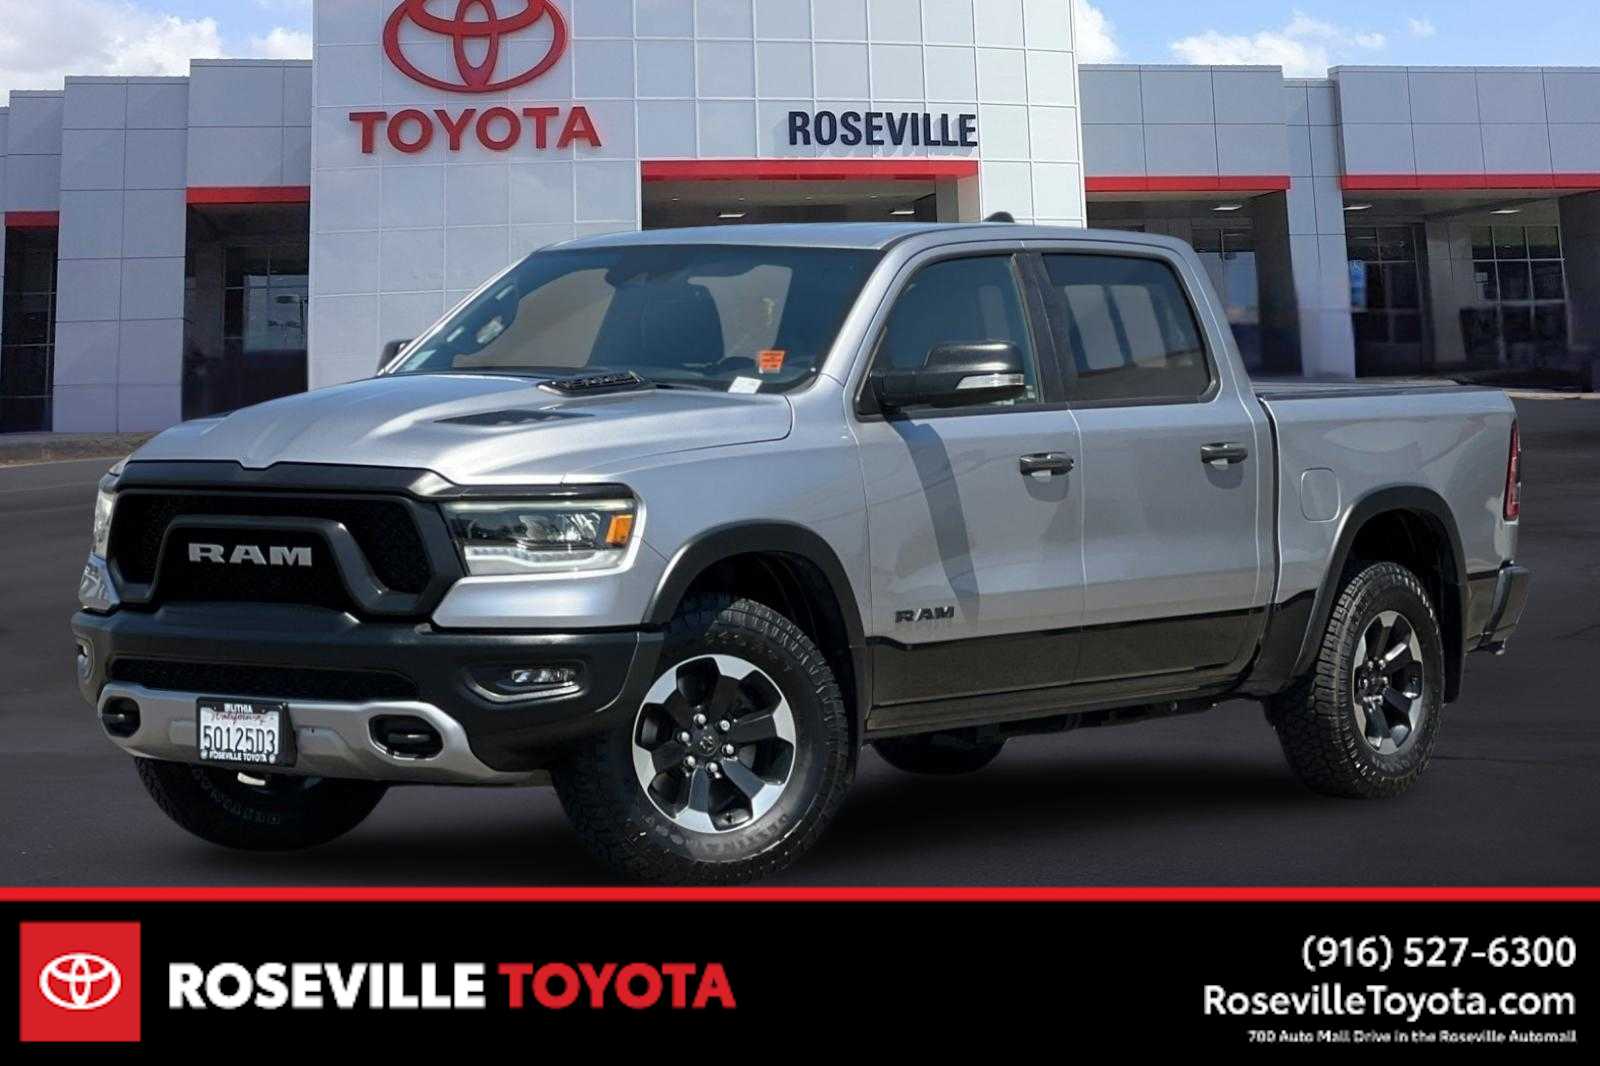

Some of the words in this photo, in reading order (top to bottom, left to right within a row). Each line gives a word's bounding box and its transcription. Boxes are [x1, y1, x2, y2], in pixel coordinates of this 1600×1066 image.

[349, 106, 602, 154] TOYOTA
[788, 111, 978, 147] ROSEVILLE
[188, 543, 312, 567] RAM
[895, 606, 954, 623] RAM
[203, 725, 275, 754] 50125D3
